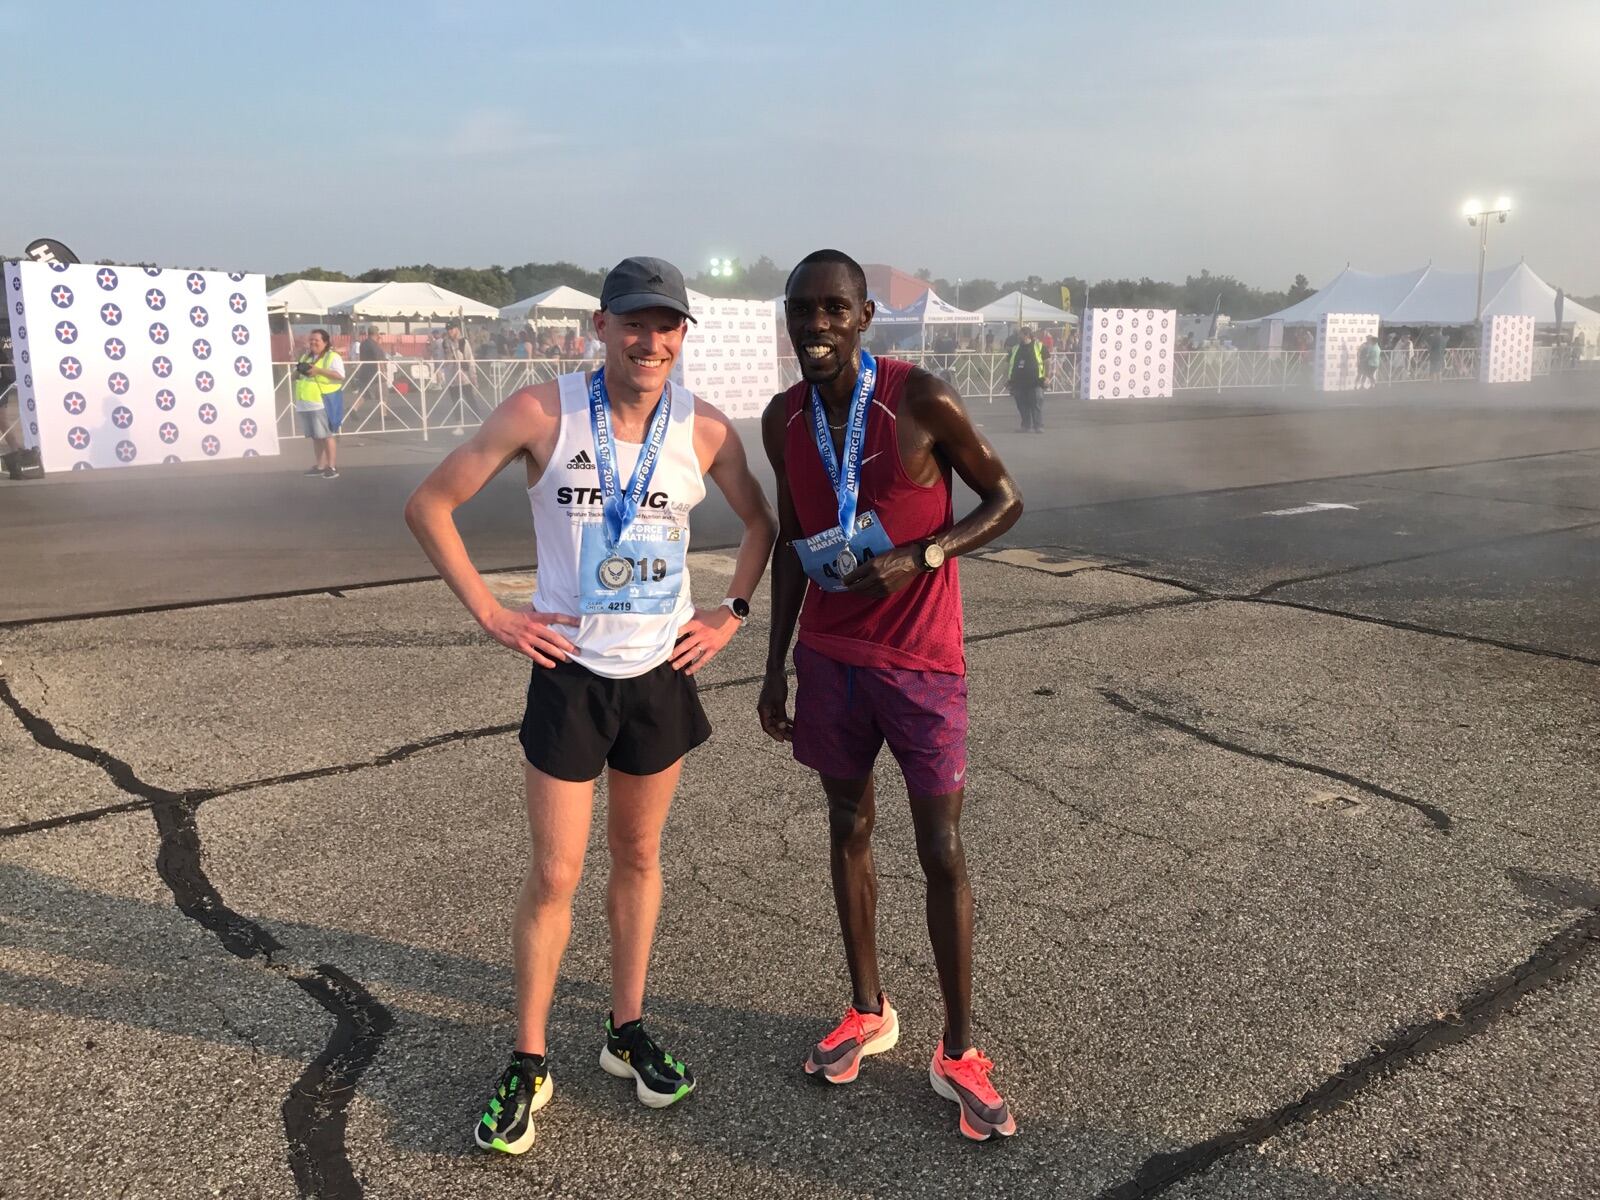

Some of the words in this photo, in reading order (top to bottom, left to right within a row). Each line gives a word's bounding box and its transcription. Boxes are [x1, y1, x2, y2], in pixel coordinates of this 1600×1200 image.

[854, 368, 873, 428] MARATHON
[593, 378, 608, 447] SEPTEMBER
[603, 468, 615, 497] 2022
[849, 431, 860, 468] FORCE
[566, 462, 596, 470] adidas
[632, 483, 644, 504] AIR
[639, 446, 658, 481] FORCE
[846, 471, 856, 491] AIR
[557, 487, 669, 509] STRG
[806, 535, 822, 547] AIR
[823, 526, 844, 539] FOR
[607, 602, 632, 611] 4219
